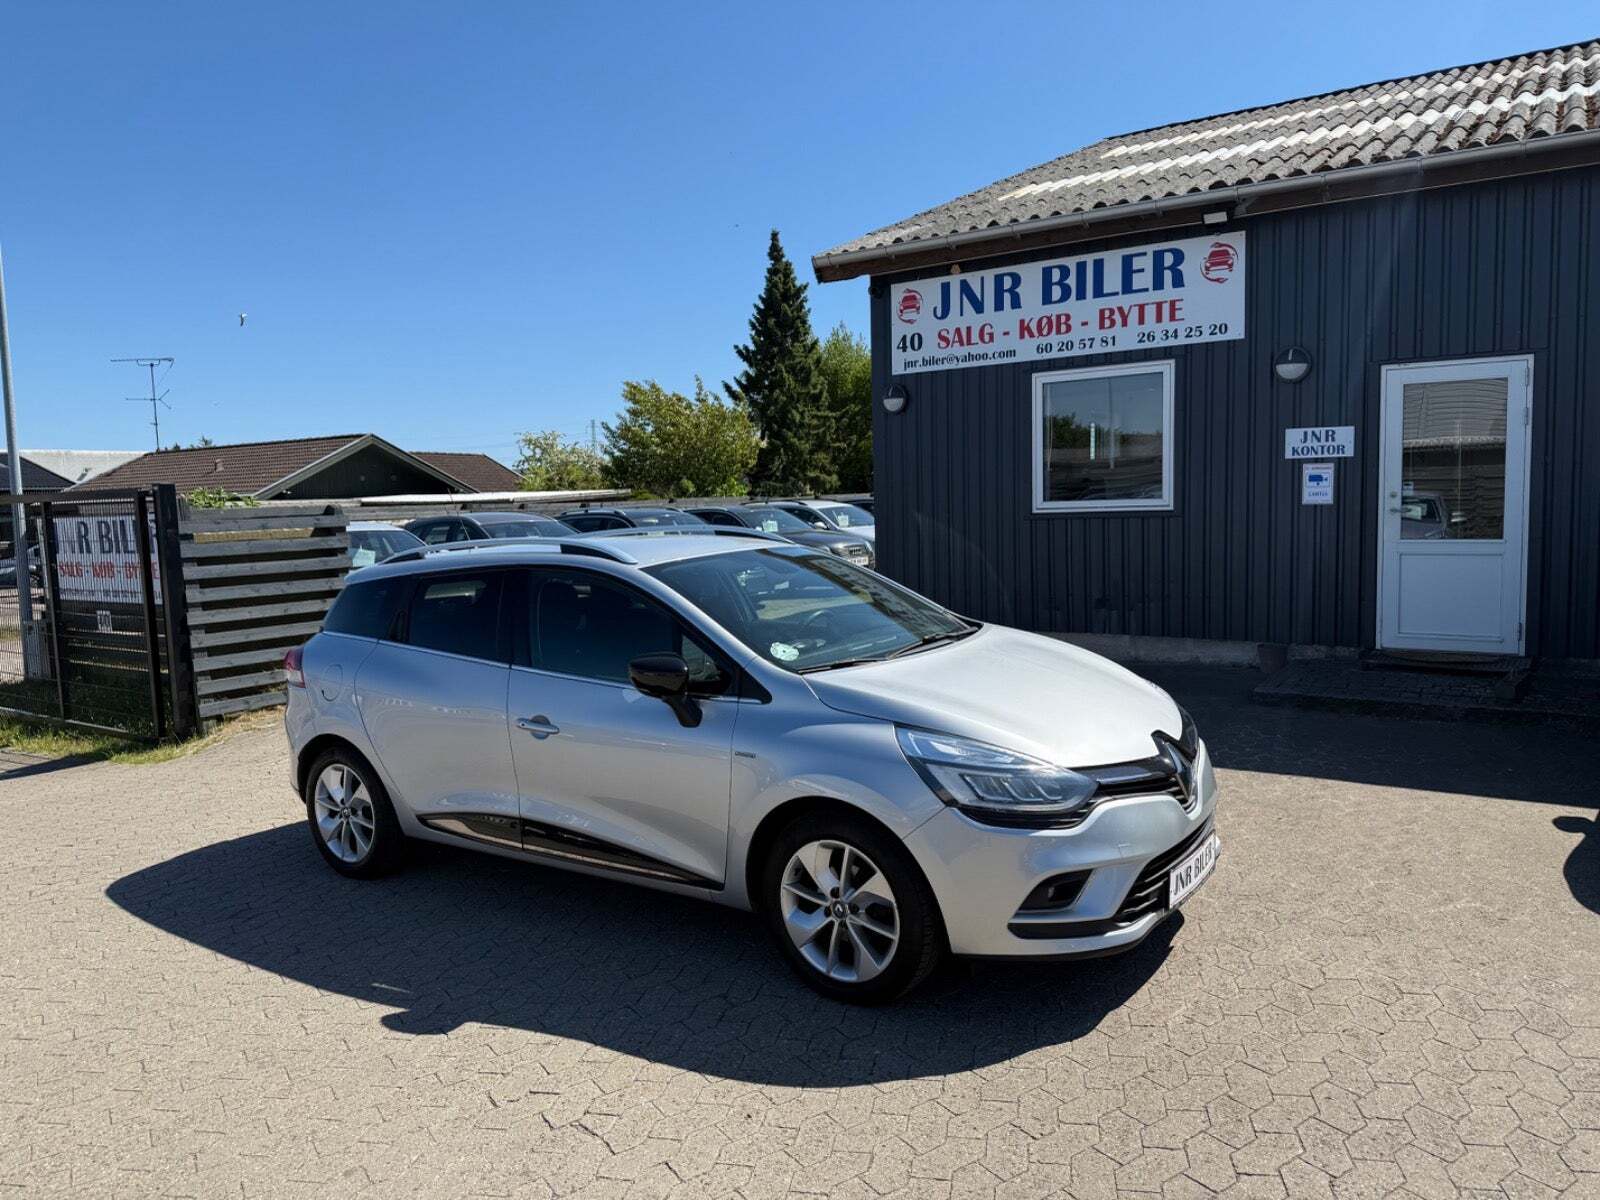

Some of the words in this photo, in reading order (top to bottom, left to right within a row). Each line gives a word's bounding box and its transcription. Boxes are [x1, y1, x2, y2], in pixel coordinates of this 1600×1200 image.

[932, 271, 1023, 320] JNR
[1041, 247, 1186, 306] BILER
[896, 332, 923, 353] 40
[903, 349, 1017, 371] jnr.biler@yahoo.com
[1036, 343, 1053, 354] 60
[1057, 340, 1074, 352] 20
[1078, 337, 1096, 349] 57
[1100, 335, 1117, 347] 81
[1136, 331, 1155, 344] 26
[1160, 328, 1179, 340] 34
[1184, 325, 1203, 338] 25
[1208, 322, 1228, 336] 20
[937, 322, 995, 349] SALG
[1018, 312, 1072, 340] KØB
[1098, 299, 1185, 330] BYTTE
[1291, 444, 1346, 456] KONTOR
[1300, 429, 1336, 444] JNR
[1173, 865, 1192, 895] JNR
[1194, 841, 1212, 879] BILER
